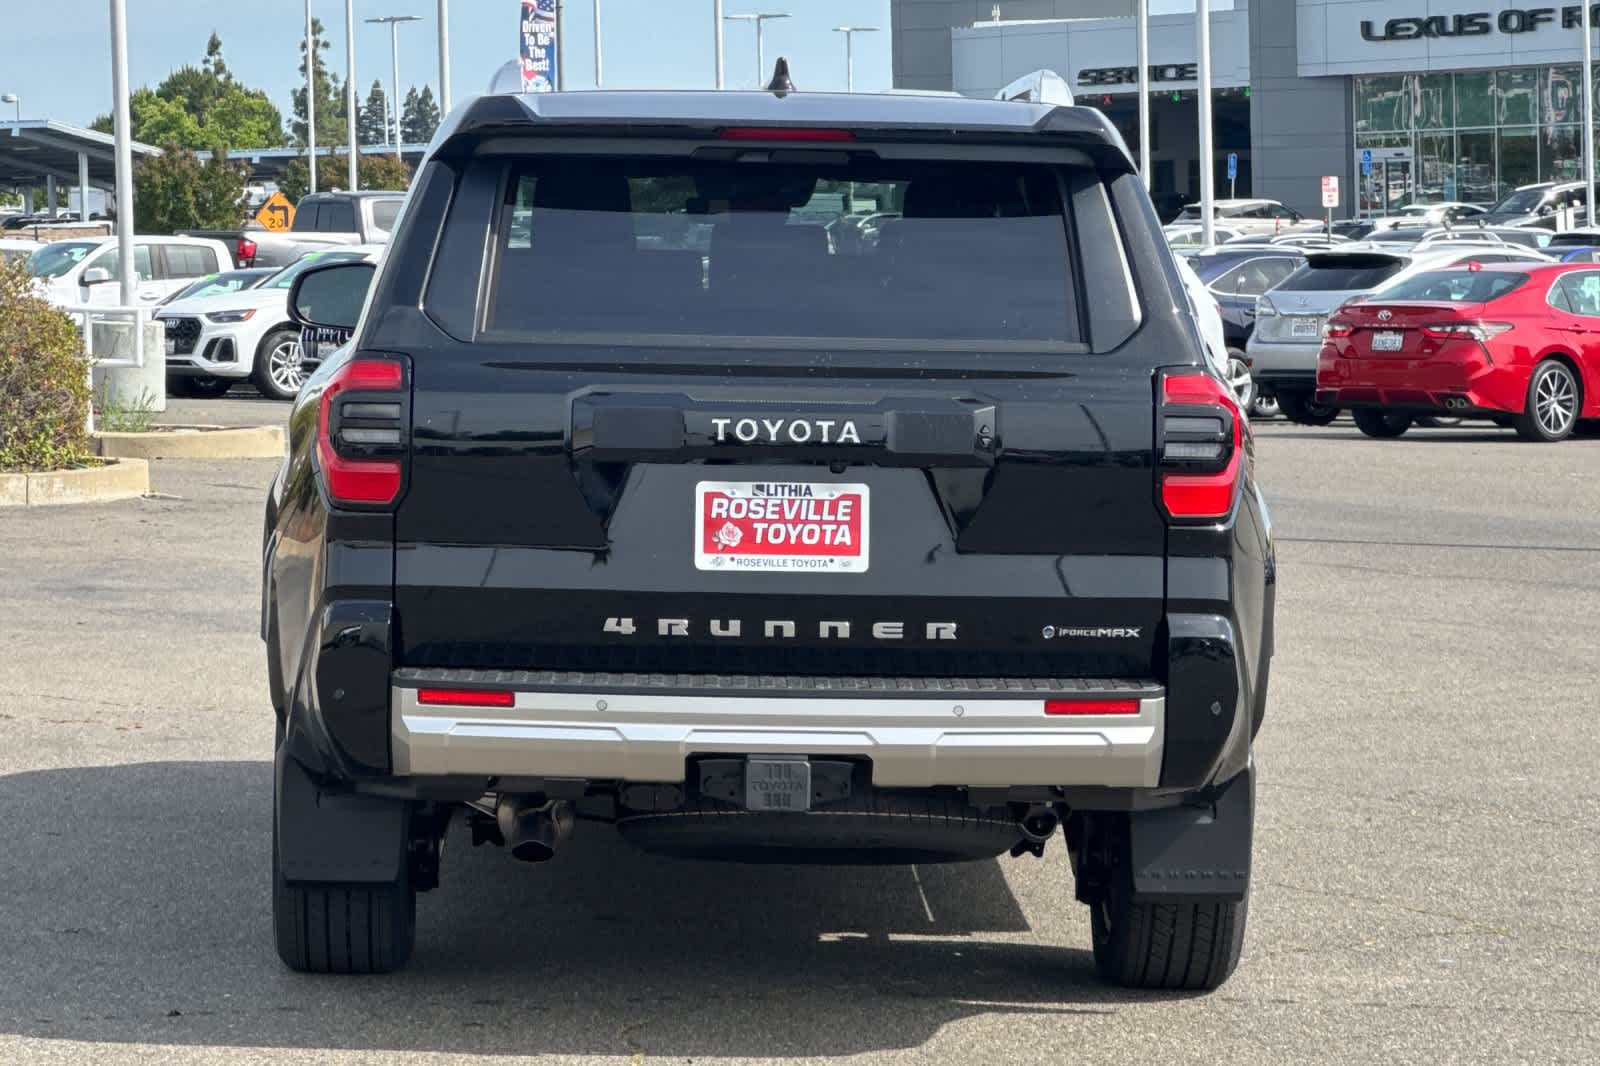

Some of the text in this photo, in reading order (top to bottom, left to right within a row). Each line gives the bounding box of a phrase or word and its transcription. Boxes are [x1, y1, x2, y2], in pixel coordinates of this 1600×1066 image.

[522, 20, 553, 33] Driven
[1360, 12, 1493, 41] LEXUS
[1497, 8, 1556, 33] OF
[524, 32, 551, 46] To Be
[528, 46, 546, 58] The
[525, 58, 550, 72] Best!
[268, 217, 284, 229] 20
[711, 417, 861, 444] TOYOTA
[766, 484, 813, 498] LITHIA
[711, 497, 853, 521] ROSEVILLE
[752, 522, 852, 546] TOYOTA
[736, 557, 829, 569] ROSEVILLE TOYOTA
[603, 617, 956, 640] 4RUNNER
